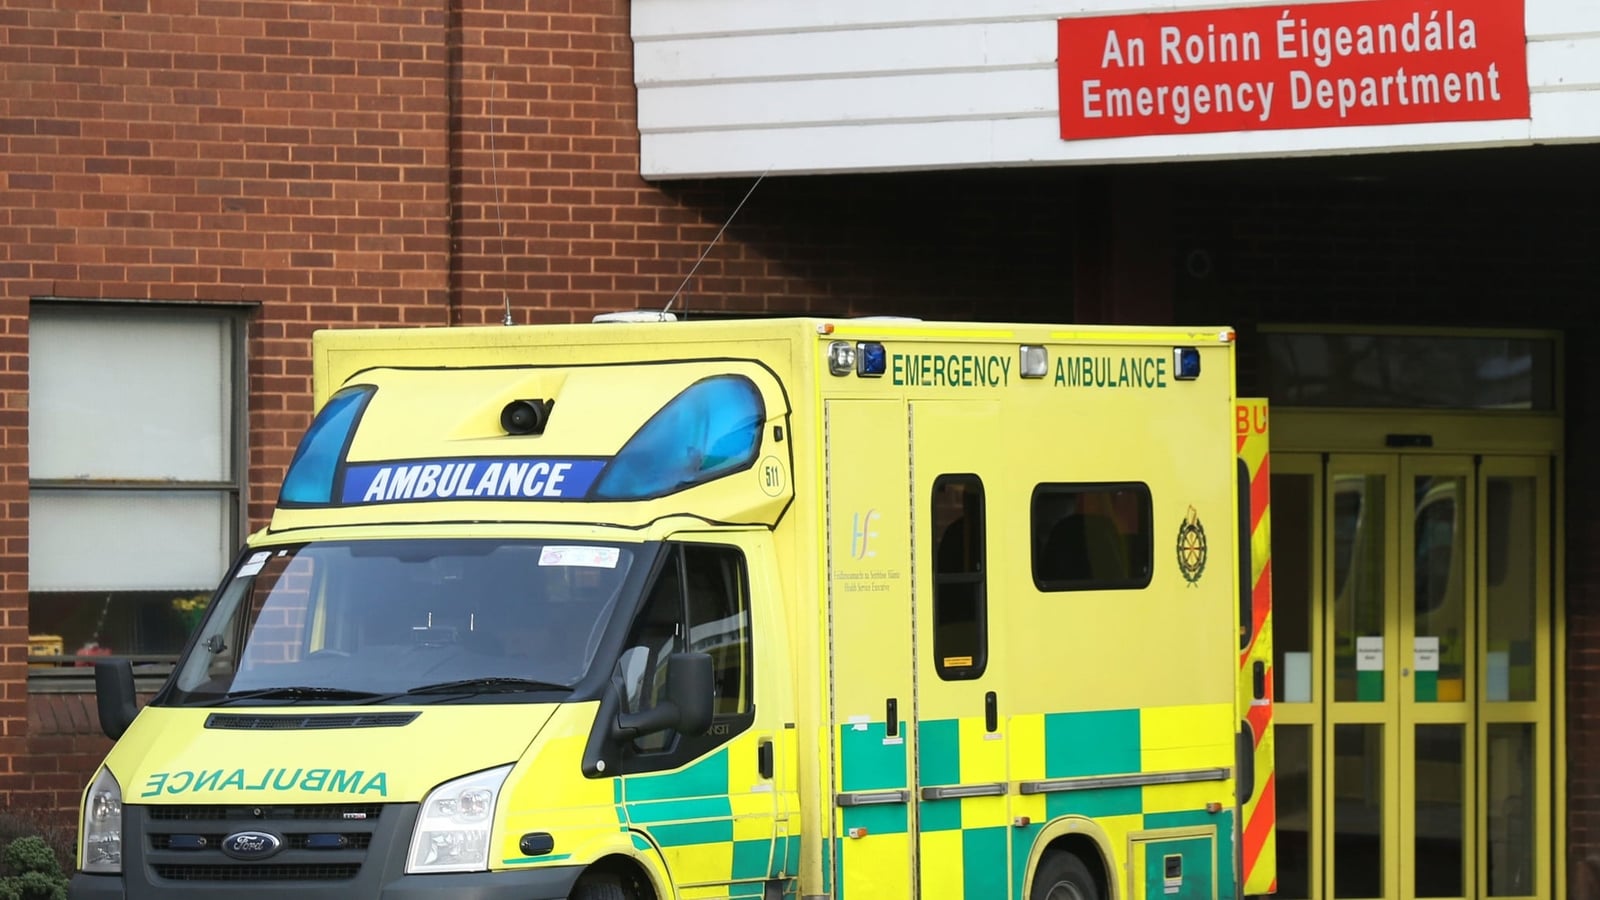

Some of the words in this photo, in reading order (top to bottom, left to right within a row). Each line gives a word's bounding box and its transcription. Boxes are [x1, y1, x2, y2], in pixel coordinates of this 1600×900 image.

[1101, 29, 1145, 68] An
[1160, 24, 1261, 65] Roinn
[1276, 10, 1477, 68] Éigeandála
[1082, 79, 1275, 125] Emergency
[1289, 62, 1501, 118] Department
[892, 354, 1012, 388] EMERGENCY
[1054, 356, 1167, 389] AMBULANCE
[363, 462, 573, 502] AMBULANCE
[765, 465, 779, 487] 511
